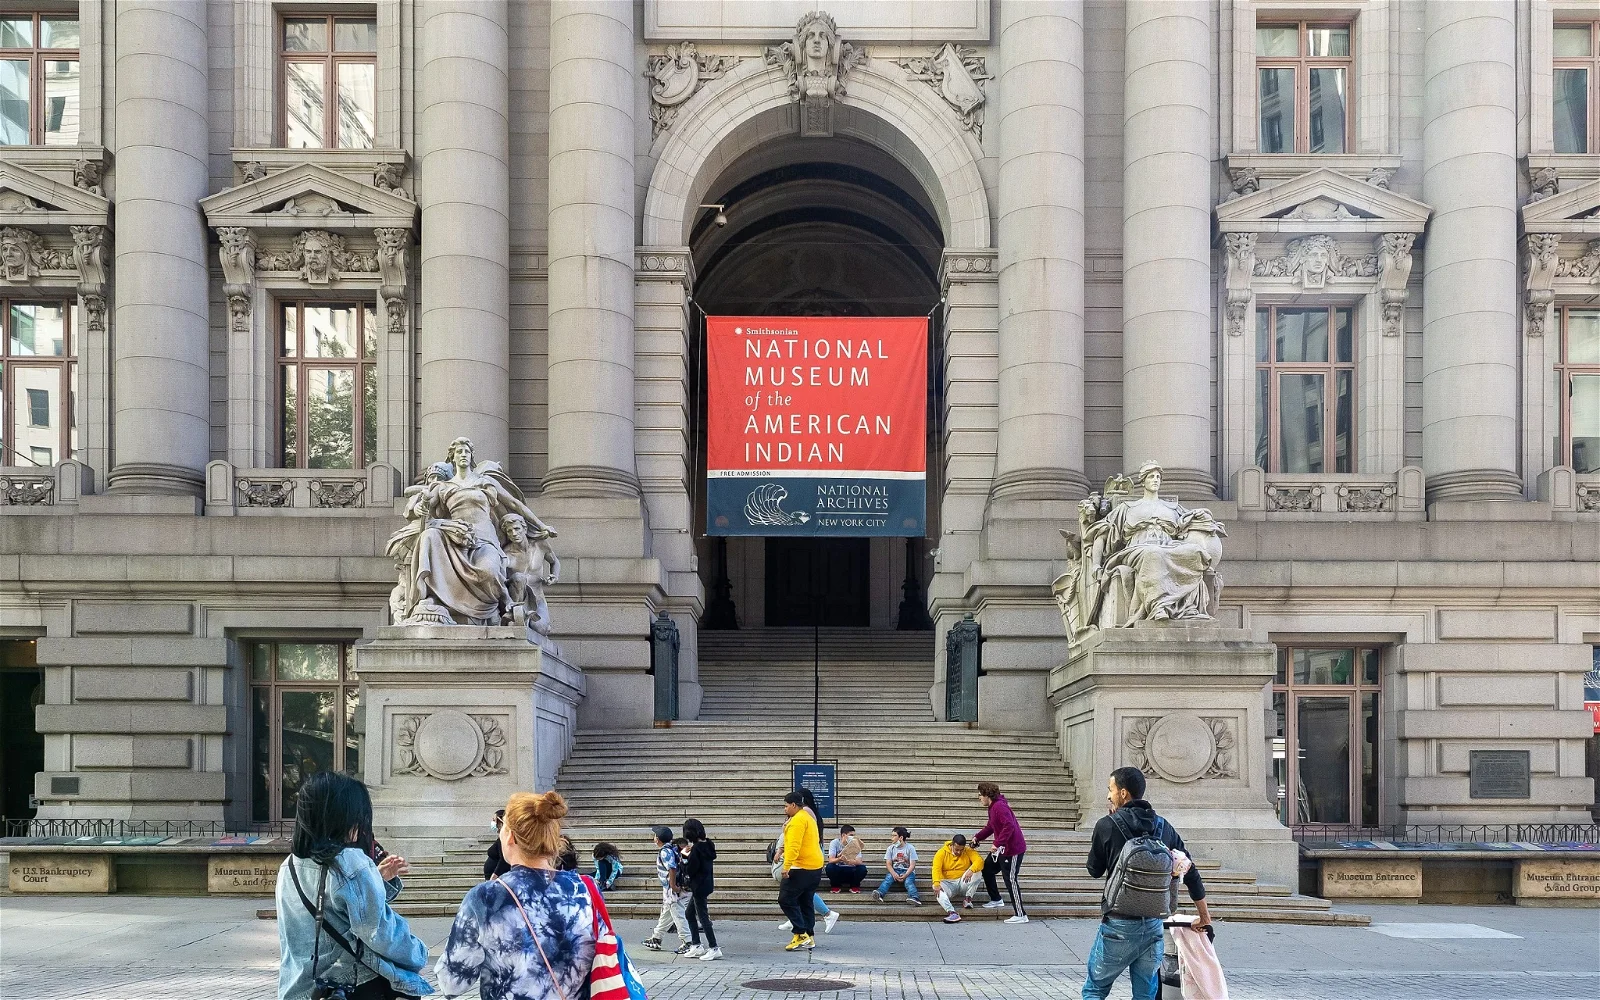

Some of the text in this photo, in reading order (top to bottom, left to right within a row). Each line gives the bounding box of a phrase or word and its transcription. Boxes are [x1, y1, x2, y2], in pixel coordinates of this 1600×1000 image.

[746, 327, 799, 336] Smithsonian
[745, 339, 889, 359] NATIONAL
[745, 366, 870, 387] MUSEUM
[745, 390, 792, 411] of the
[744, 414, 891, 435] AMERICAN
[745, 442, 844, 463] INDIAN
[817, 485, 889, 496] NATIONAL
[816, 497, 889, 509] ARCHIVES
[818, 518, 887, 527] NEW YORK CITY
[22, 867, 93, 877] U.S. Bankruptcy
[214, 867, 279, 876] Museum Entra
[1337, 872, 1416, 881] Museum Entrance
[242, 877, 277, 887] and Gro
[1526, 873, 1600, 881] Museum Entranc
[1554, 883, 1571, 892] and
